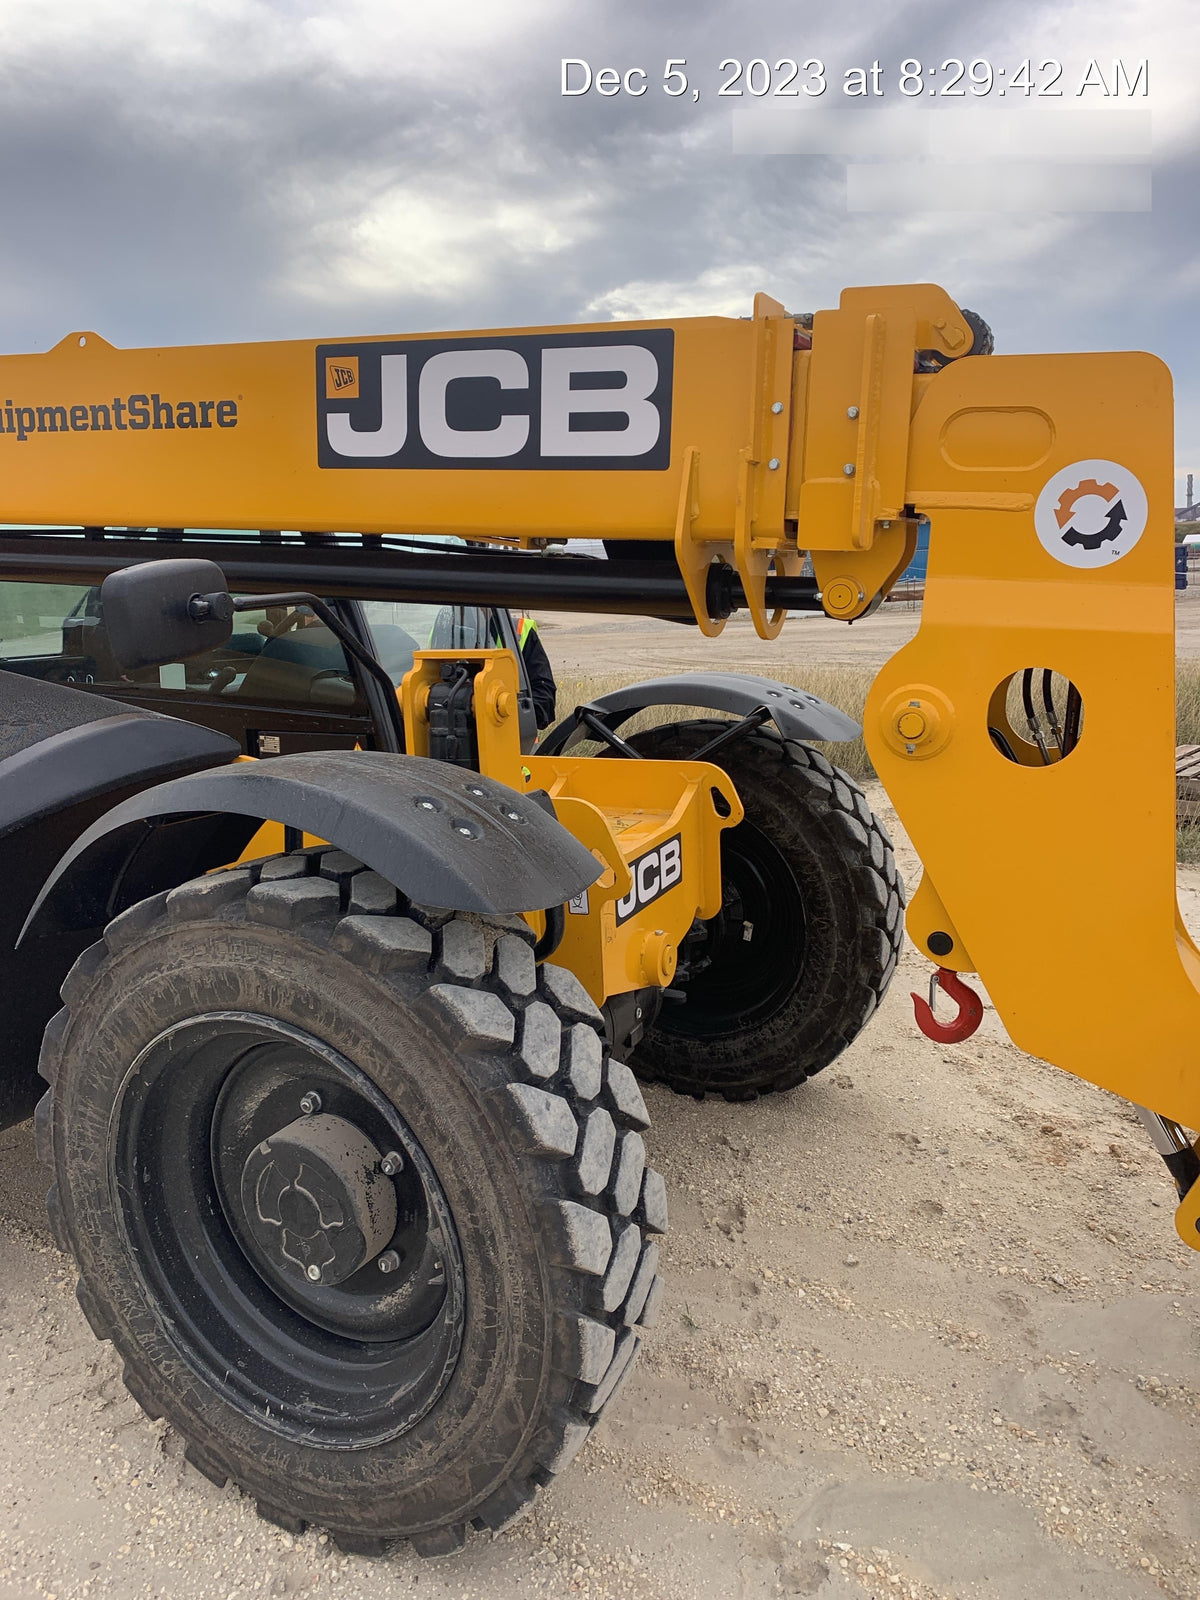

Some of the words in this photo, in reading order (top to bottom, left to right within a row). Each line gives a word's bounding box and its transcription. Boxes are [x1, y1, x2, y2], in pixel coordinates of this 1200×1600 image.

[325, 345, 660, 458] JCB
[333, 367, 354, 388] JCB
[0, 394, 238, 441] ipmentShare
[617, 839, 681, 918] JCB
